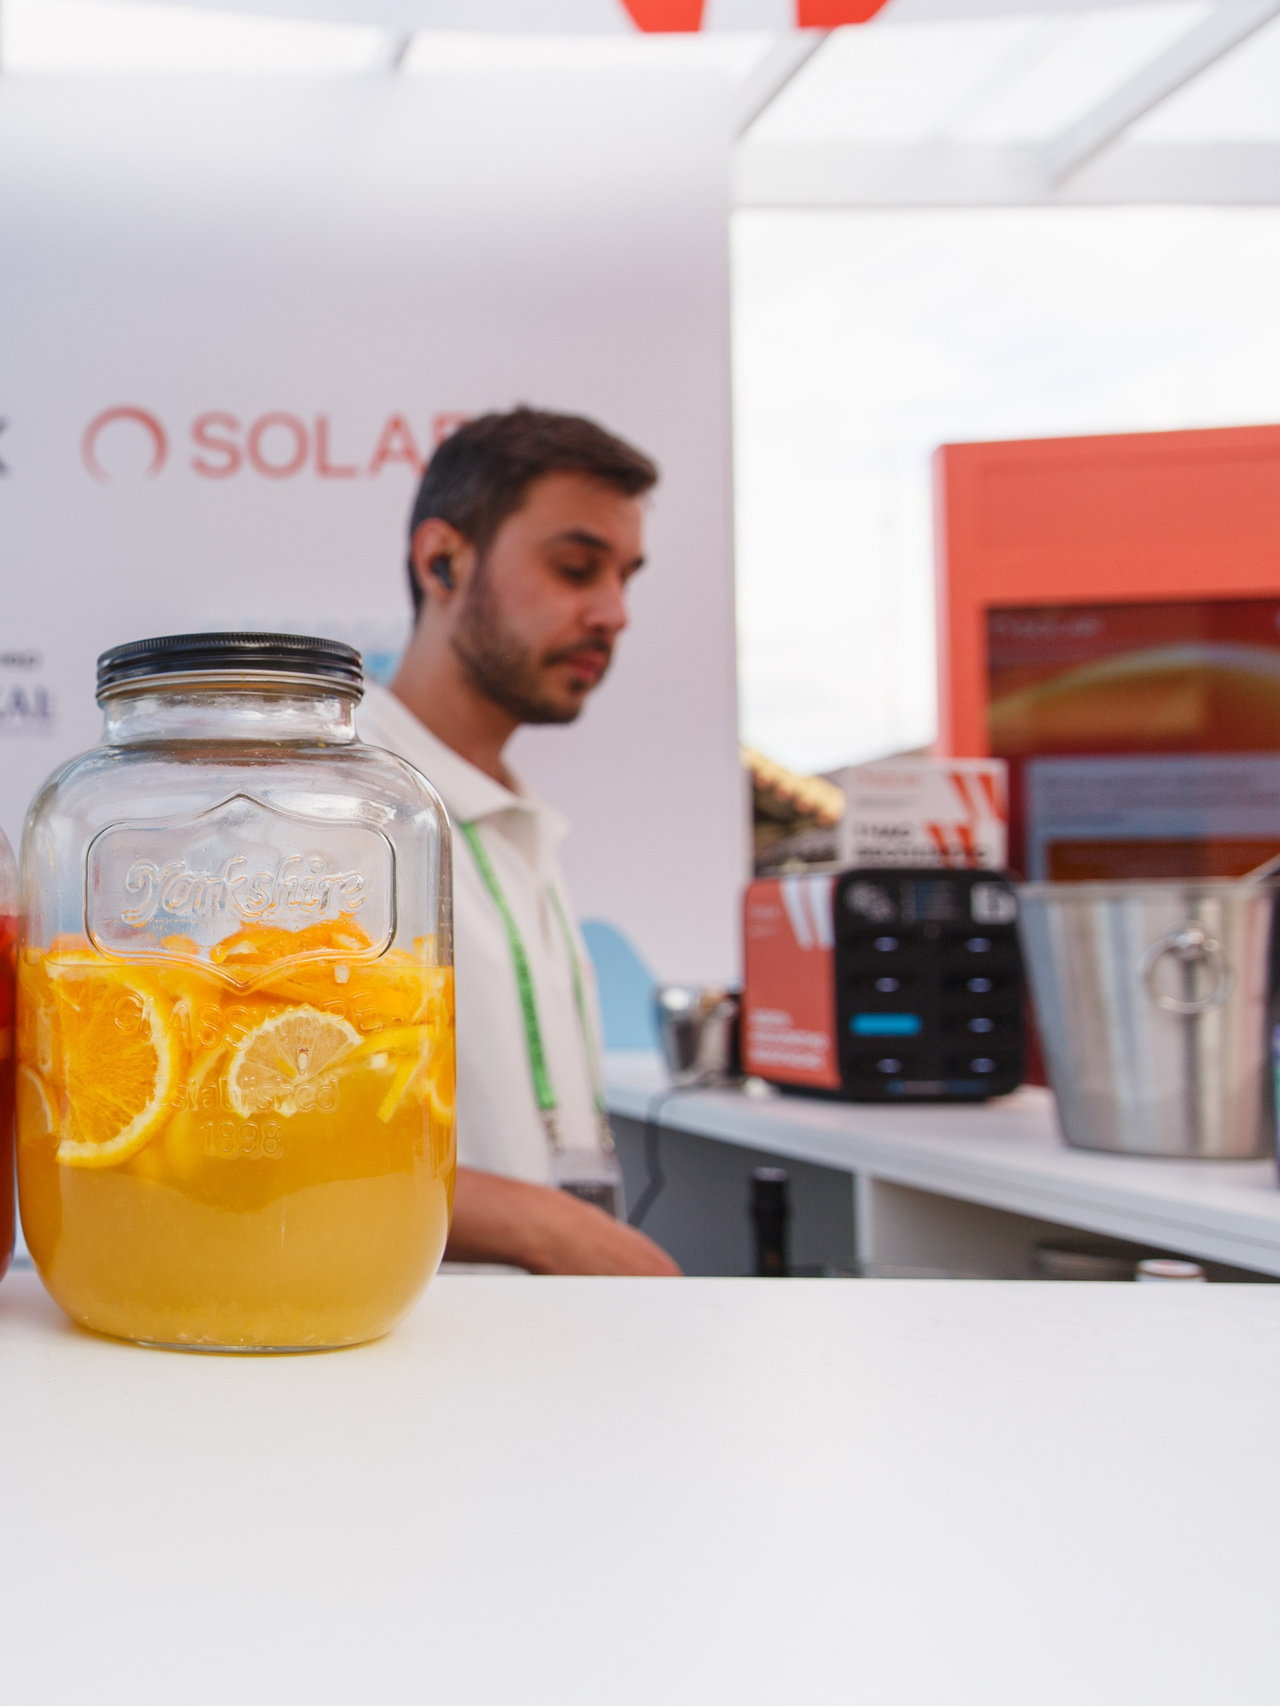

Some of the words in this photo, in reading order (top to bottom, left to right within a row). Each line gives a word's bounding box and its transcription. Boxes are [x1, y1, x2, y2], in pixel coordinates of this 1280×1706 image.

[122, 855, 366, 925] Yorkshire
[112, 992, 384, 1050] GLASSRE
[200, 1120, 284, 1158] 1898
